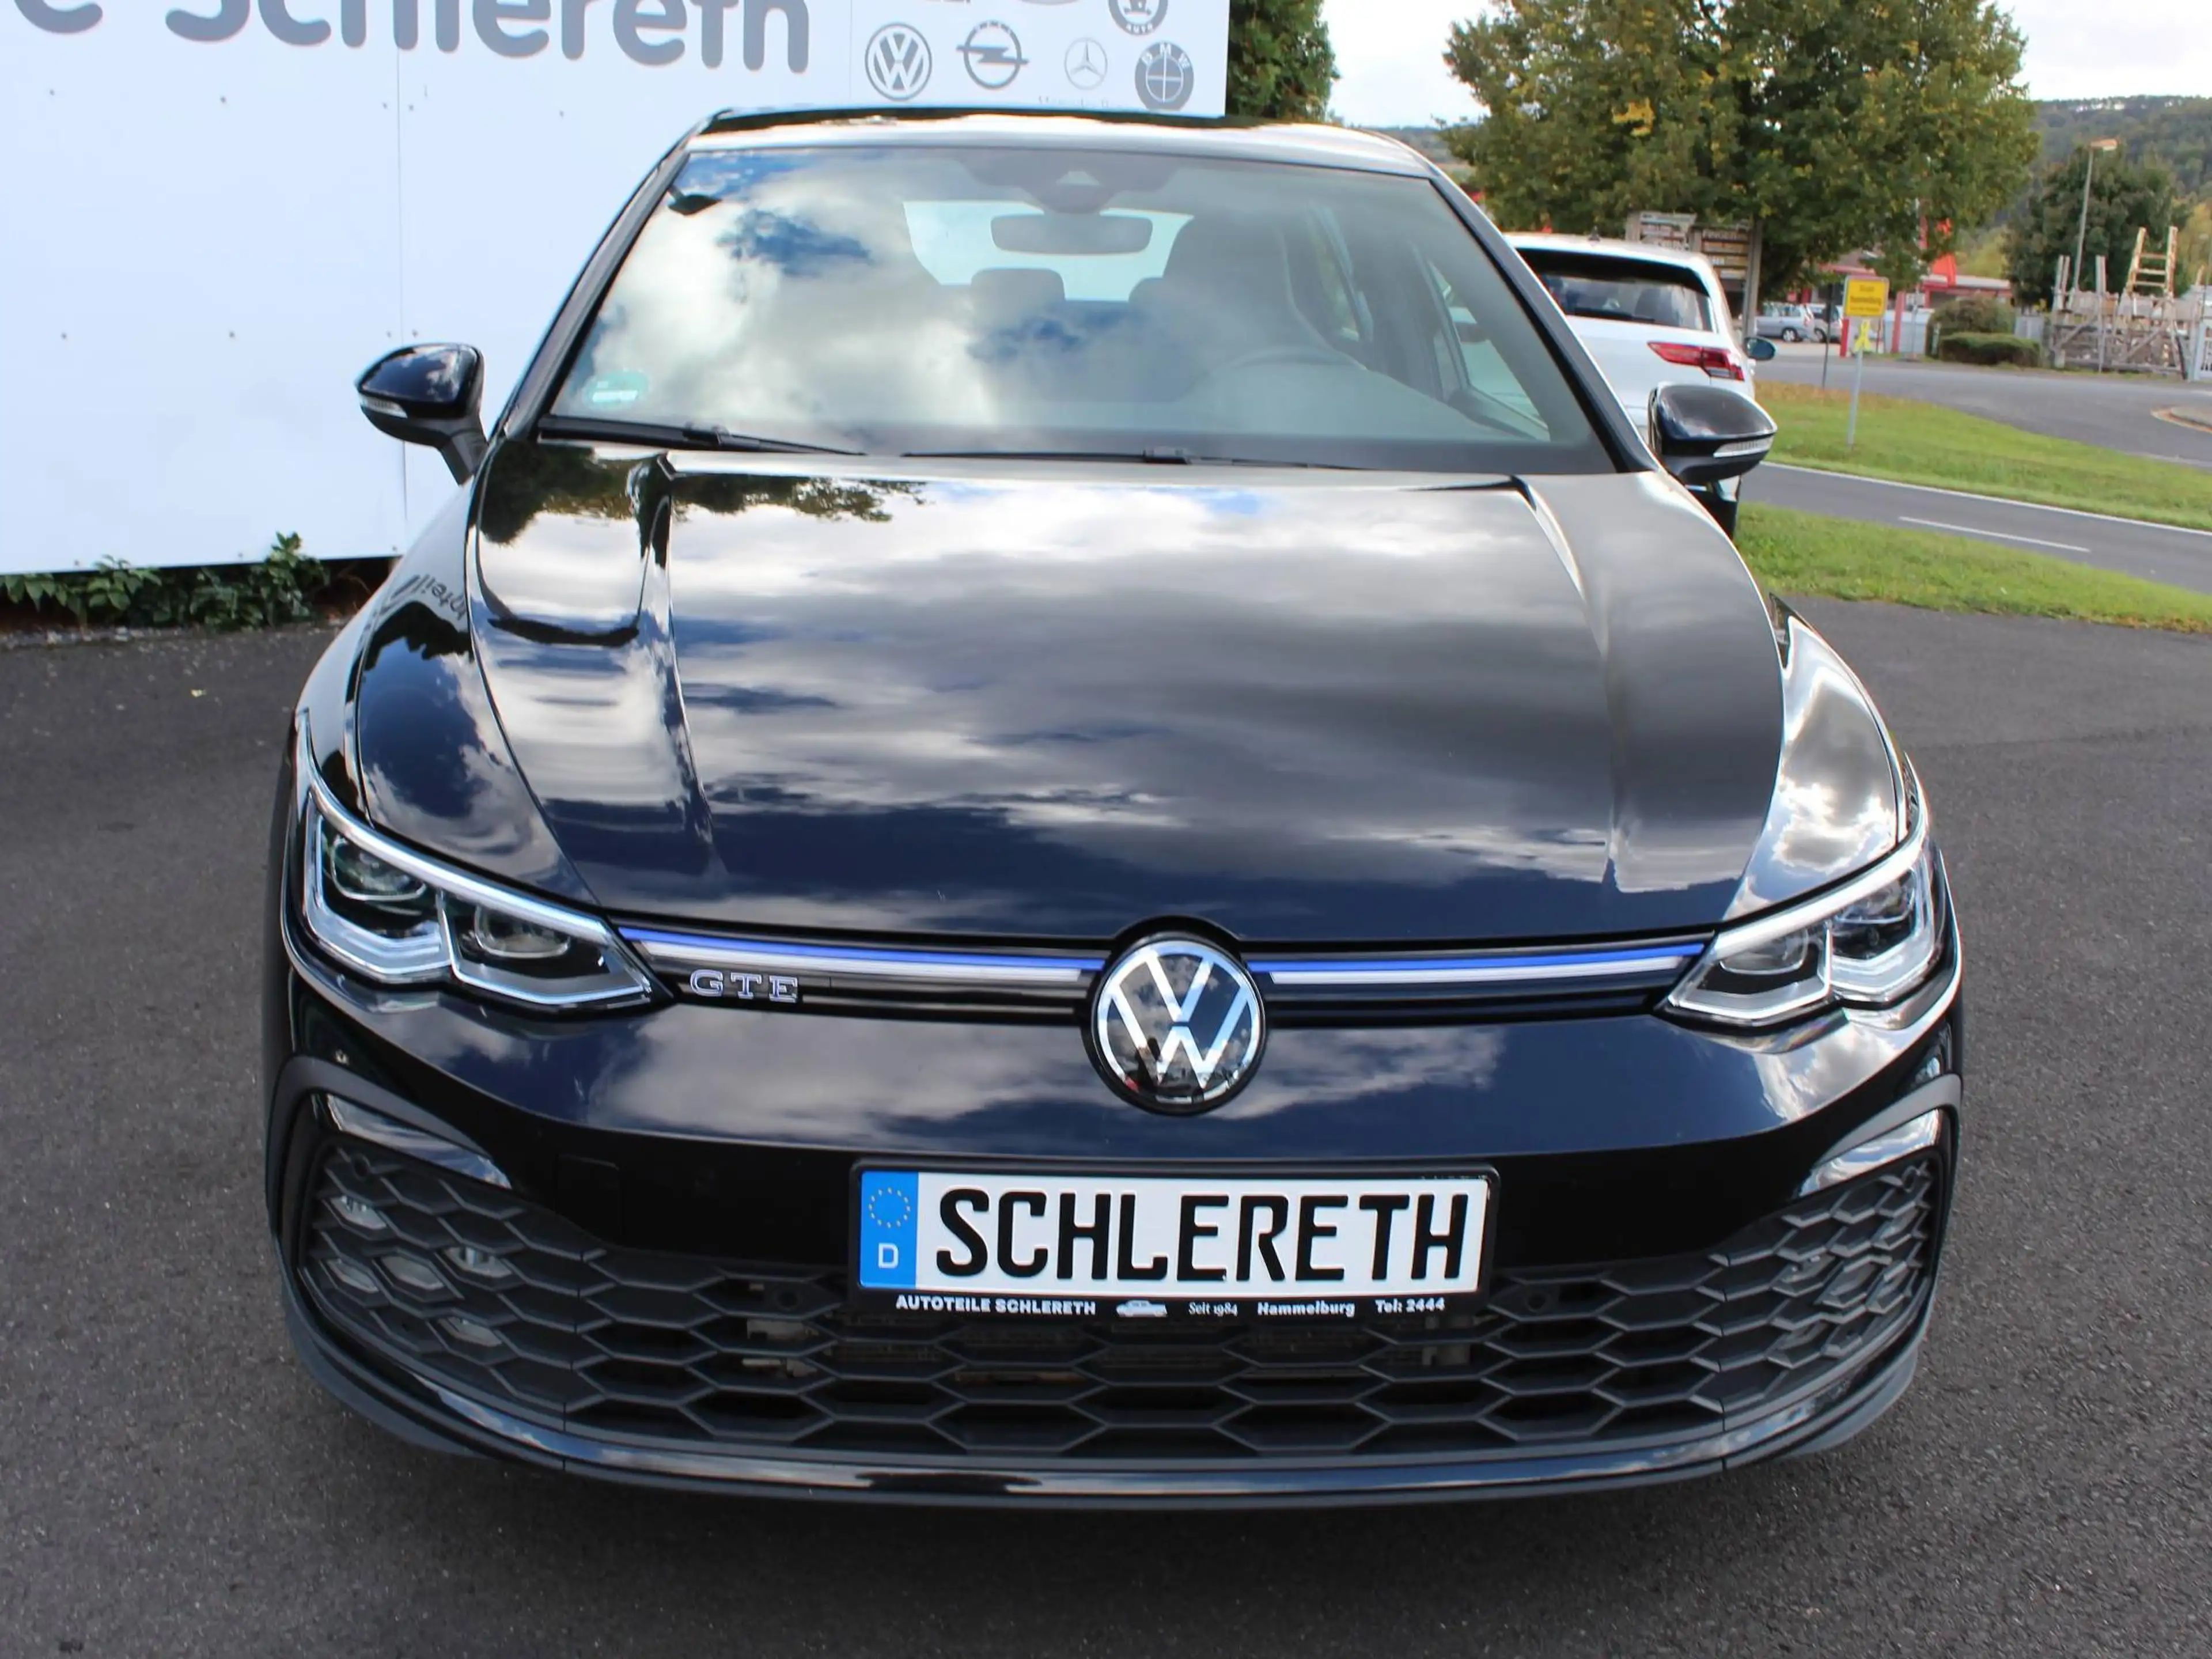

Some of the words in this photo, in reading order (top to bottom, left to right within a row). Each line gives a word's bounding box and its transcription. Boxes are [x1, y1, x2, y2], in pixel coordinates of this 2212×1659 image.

[689, 968, 799, 1003] GTE
[936, 1188, 1468, 1281] SCHLERETH
[877, 1244, 899, 1268] D
[896, 1294, 991, 1312] AUTOTEILE
[995, 1298, 1096, 1315] SCHLERETH
[1213, 1301, 1238, 1317] 1984
[1257, 1300, 1355, 1317] Hammelburg
[1406, 1297, 1445, 1313] 2444
